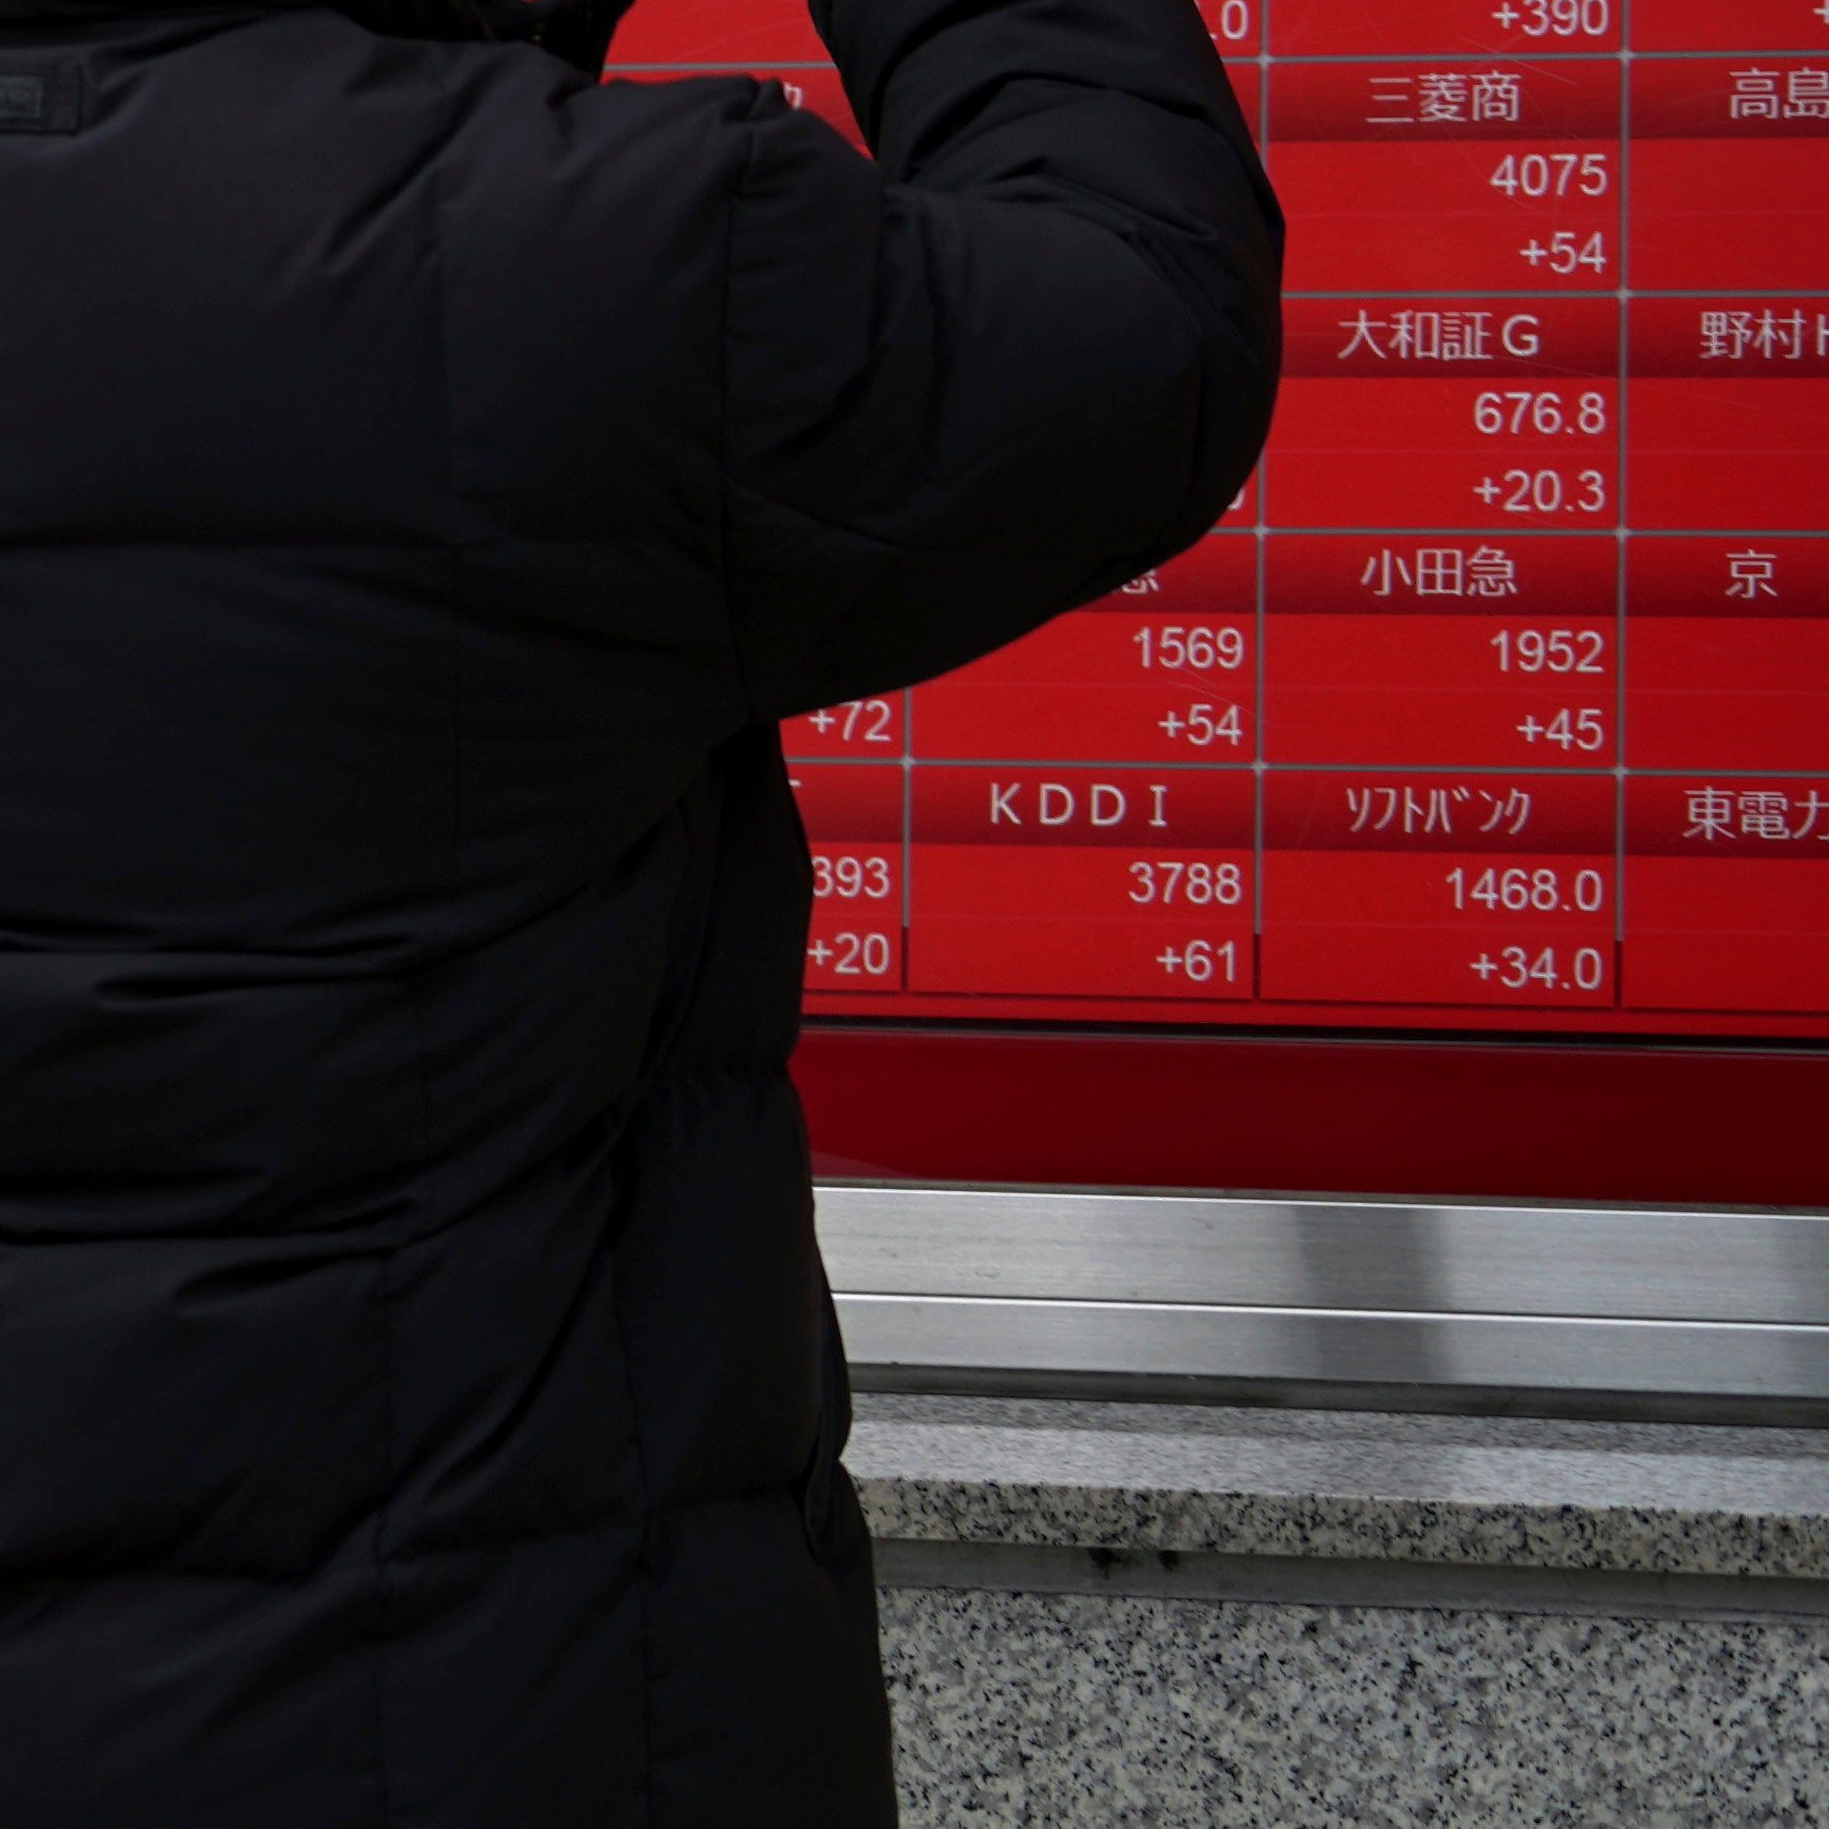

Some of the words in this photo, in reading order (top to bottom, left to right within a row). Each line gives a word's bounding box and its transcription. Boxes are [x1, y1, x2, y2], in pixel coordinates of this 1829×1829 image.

[1490, 153, 1607, 196] 4075
[1520, 231, 1607, 274] +54
[1474, 391, 1606, 434] 676.8
[1473, 469, 1605, 512] +20.3
[1133, 626, 1244, 669] 1569
[1491, 629, 1604, 673] 1952
[808, 699, 891, 741] +72
[1158, 703, 1243, 746] +54
[1516, 708, 1603, 751] +45
[1129, 861, 1241, 905] 3788
[1446, 867, 1602, 912] 1468.0
[806, 932, 890, 975] +20
[1156, 939, 1234, 982] +61
[1469, 946, 1602, 990] +34.0
